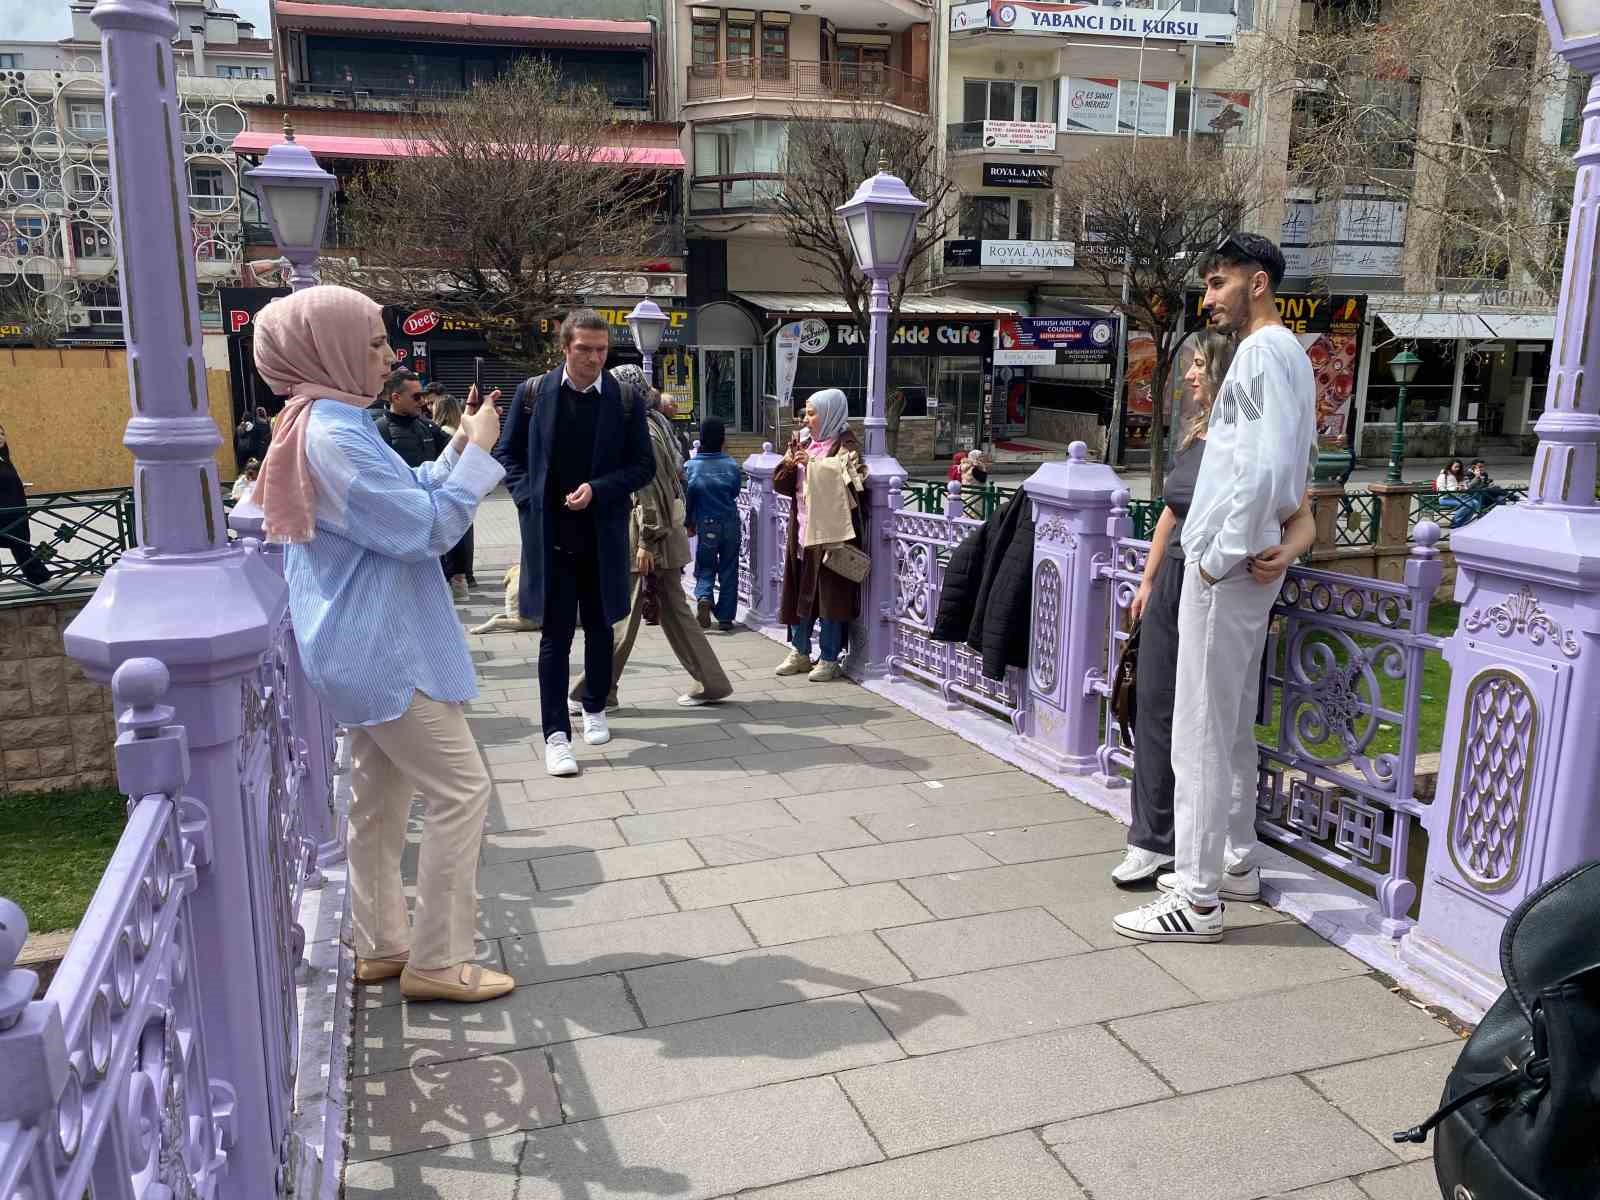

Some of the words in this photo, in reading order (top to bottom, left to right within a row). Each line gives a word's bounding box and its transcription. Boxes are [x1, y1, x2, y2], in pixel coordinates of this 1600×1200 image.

[1031, 11, 1104, 30] YABANCI
[1110, 14, 1137, 32] DİL
[1142, 19, 1199, 36] KURSU
[990, 167, 1019, 176] ROYAL
[989, 246, 1029, 257] ROYAL
[1032, 246, 1071, 257] AJANS
[936, 325, 981, 344] Cafe
